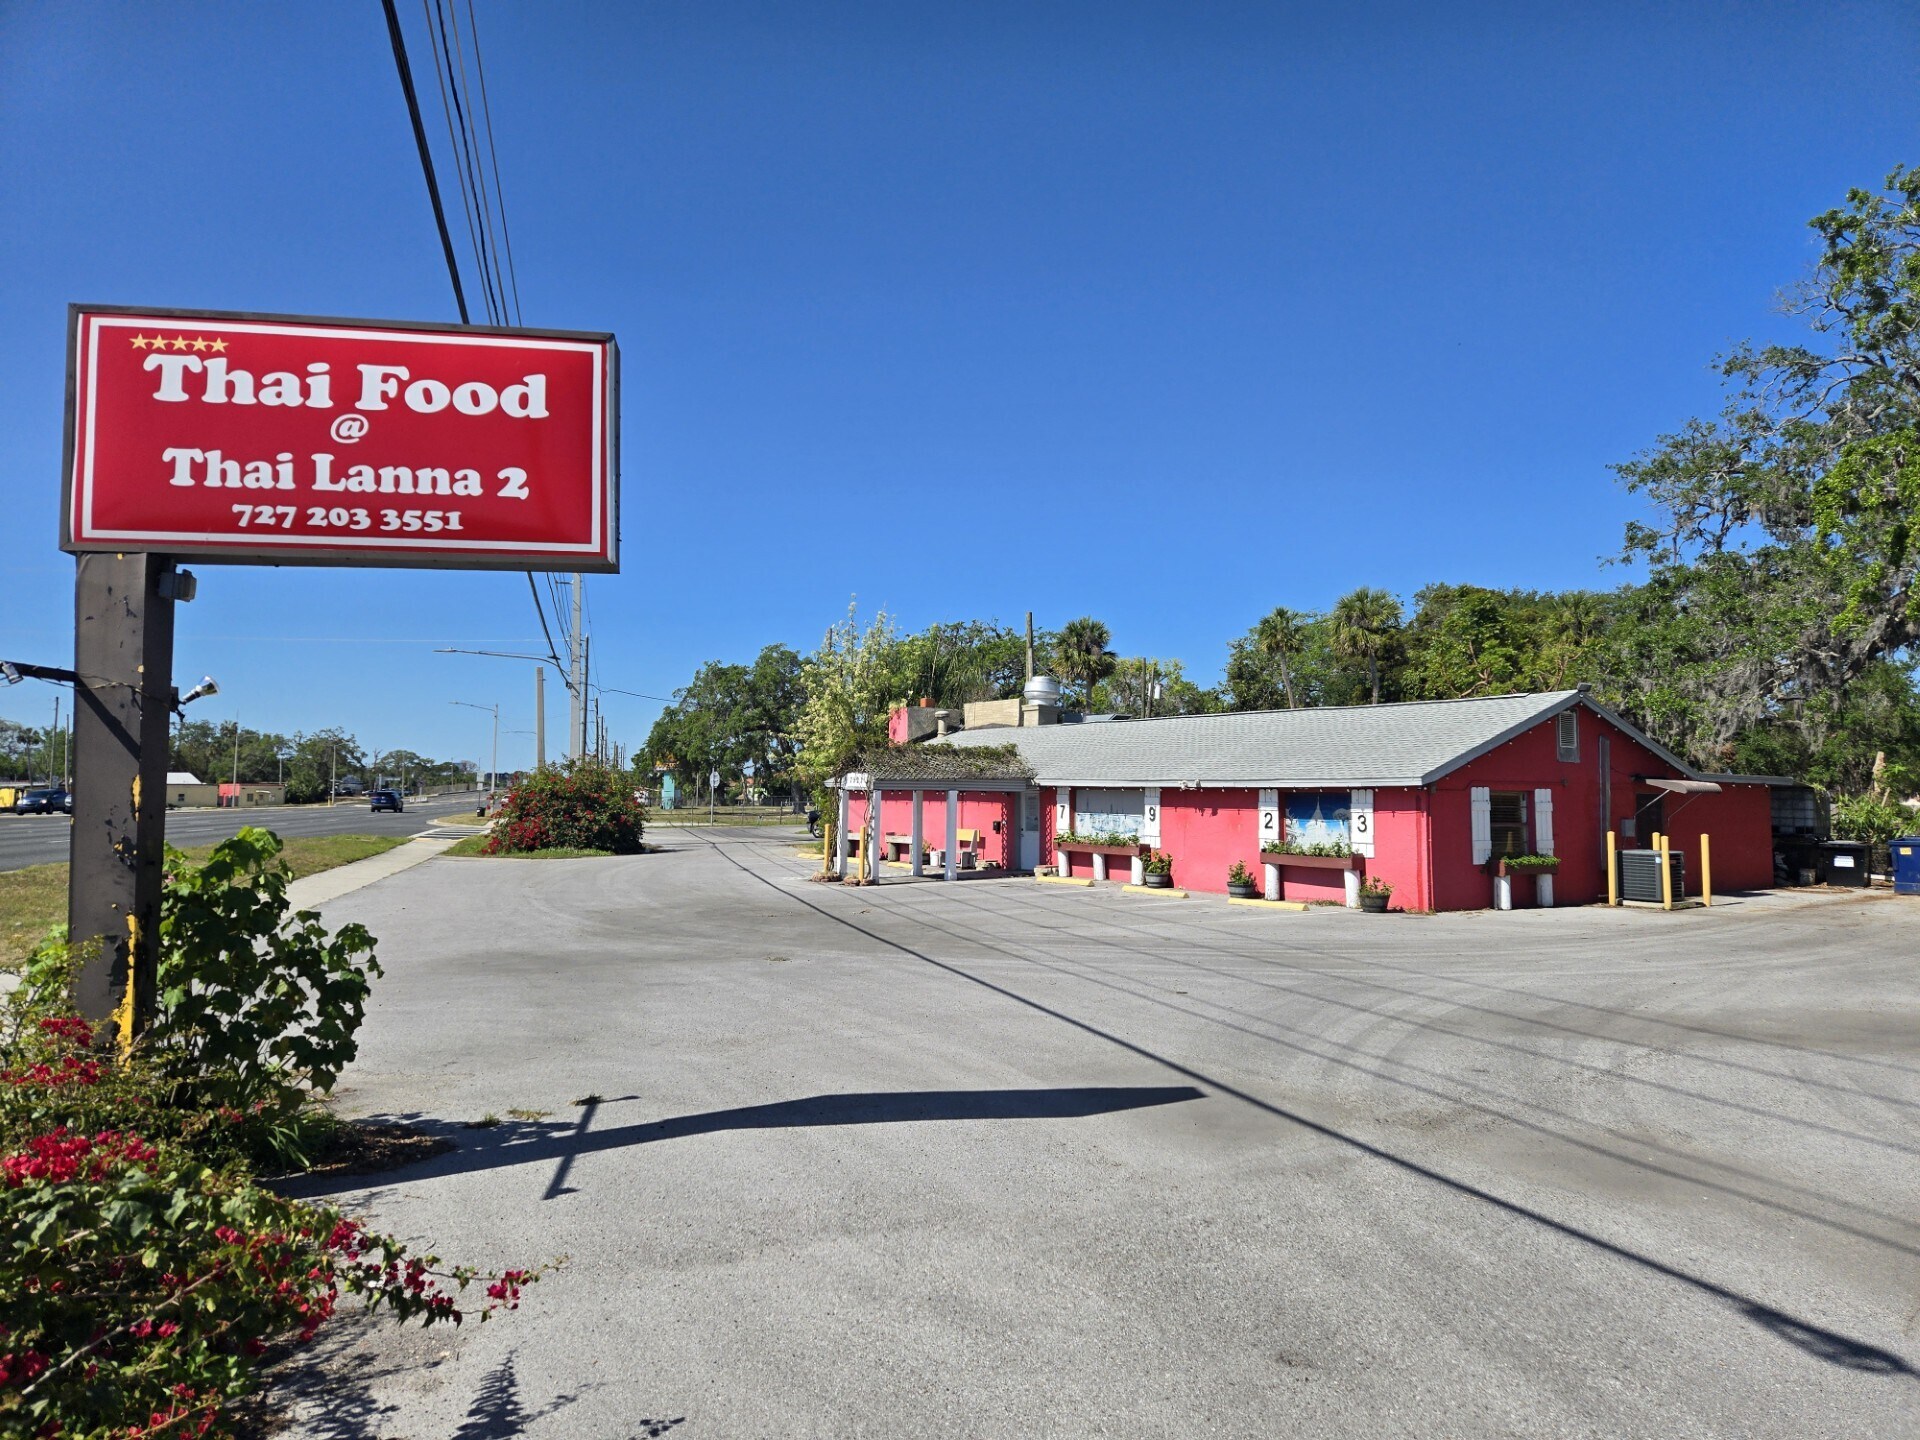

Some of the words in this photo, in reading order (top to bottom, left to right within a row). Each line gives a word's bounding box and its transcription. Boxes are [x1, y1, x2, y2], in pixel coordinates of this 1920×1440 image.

[142, 353, 334, 409] Thai
[354, 363, 550, 419] Food
[330, 413, 370, 444] @
[162, 447, 296, 490] Thai
[310, 453, 484, 497] Lanna
[496, 466, 530, 500] 2
[231, 503, 298, 529] 727
[306, 506, 371, 530] 203
[379, 509, 464, 532] 3551
[1060, 805, 1066, 819] 7
[1149, 807, 1156, 821] 9
[1264, 812, 1273, 829] 2
[1357, 814, 1367, 833] 3
